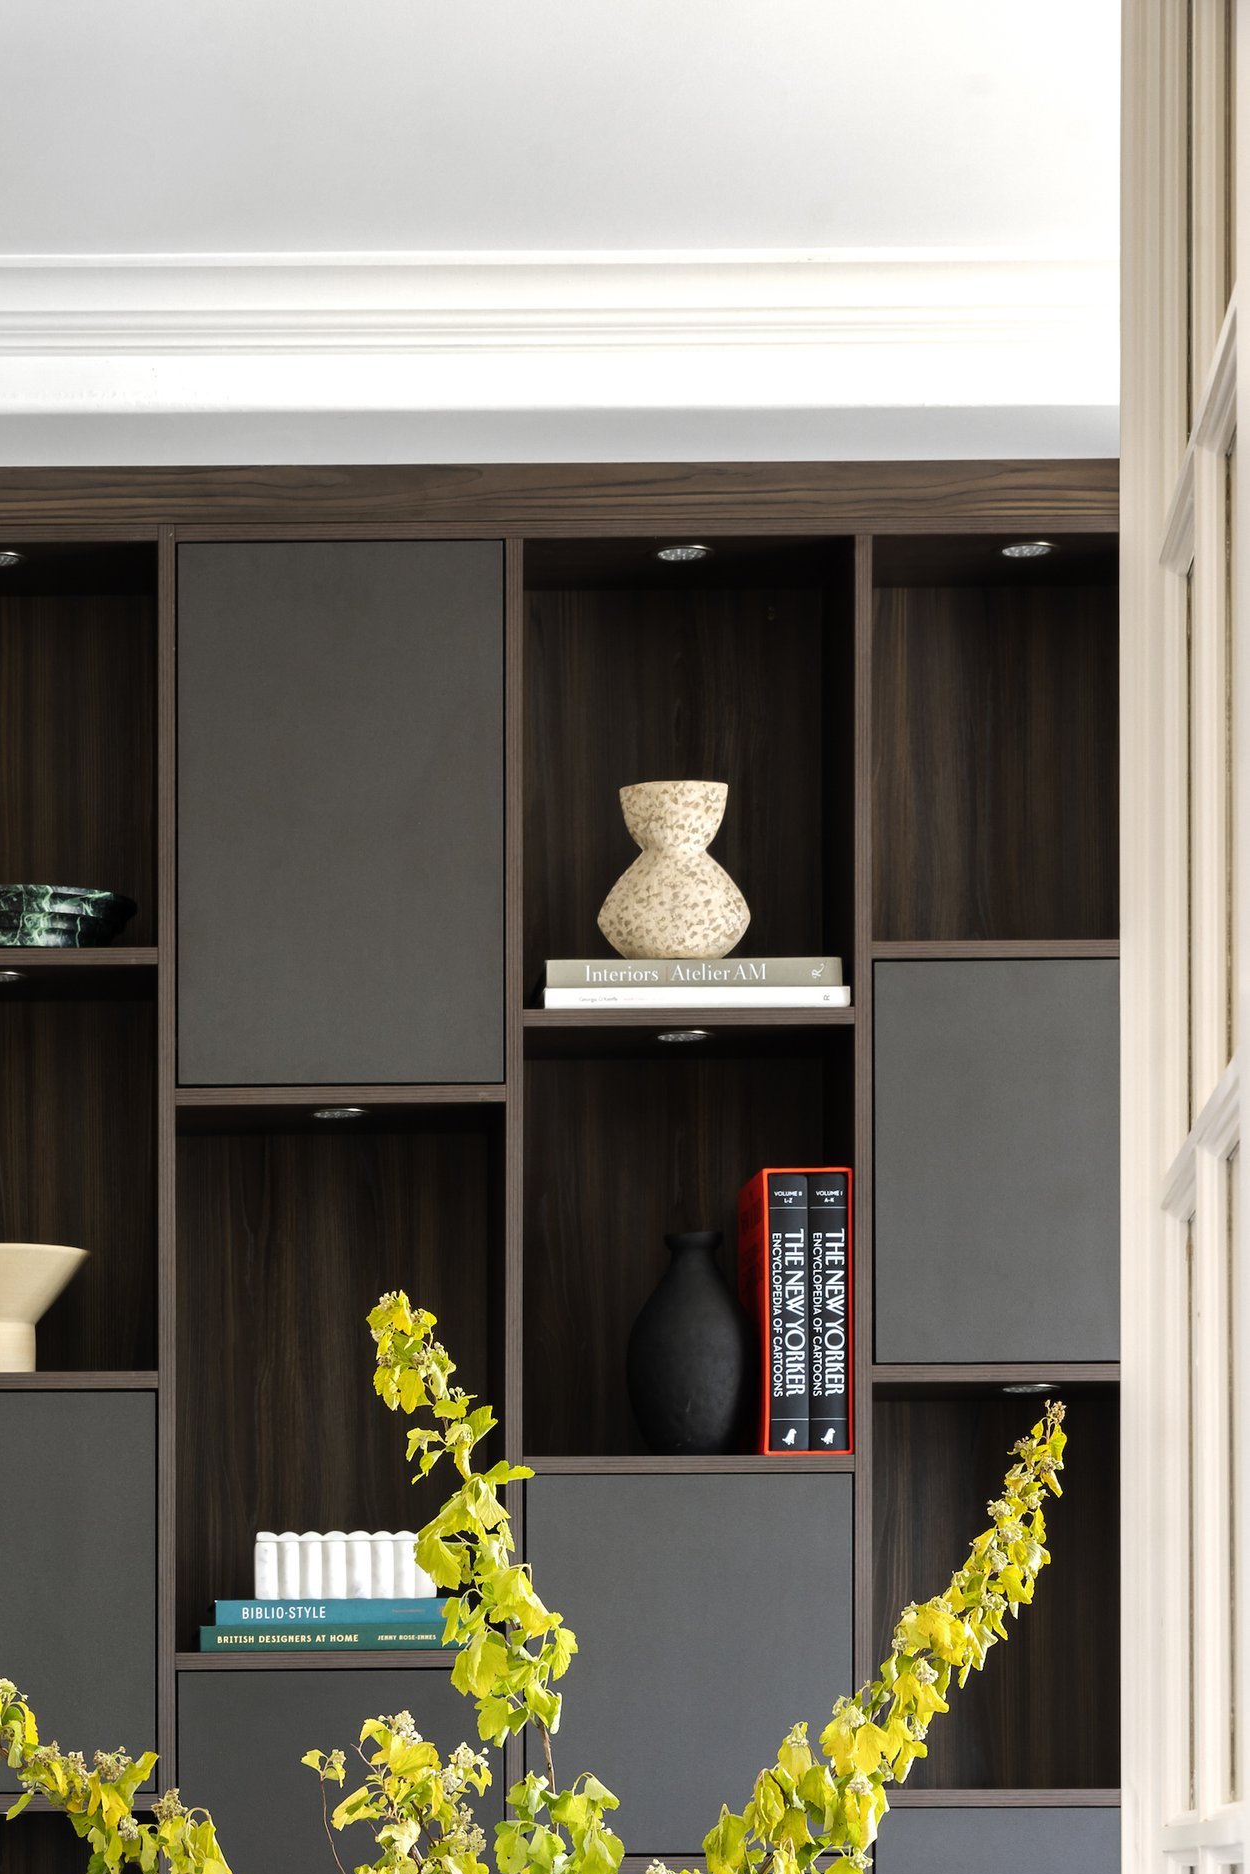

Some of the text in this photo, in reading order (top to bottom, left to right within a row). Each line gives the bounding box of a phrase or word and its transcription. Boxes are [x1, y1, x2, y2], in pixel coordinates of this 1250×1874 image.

[585, 963, 767, 982] Interiors Atelier AM
[772, 1232, 783, 1398] ENCYCLOPEDIA OF CARTOONS
[784, 1228, 806, 1397] THE NEW YORKER
[812, 1232, 823, 1397] ENCYCLOPEDIA OF CARTOONS
[824, 1227, 846, 1397] THE NEW YORKER
[217, 1634, 359, 1644] BRITISH DESIGNERS AT HOME
